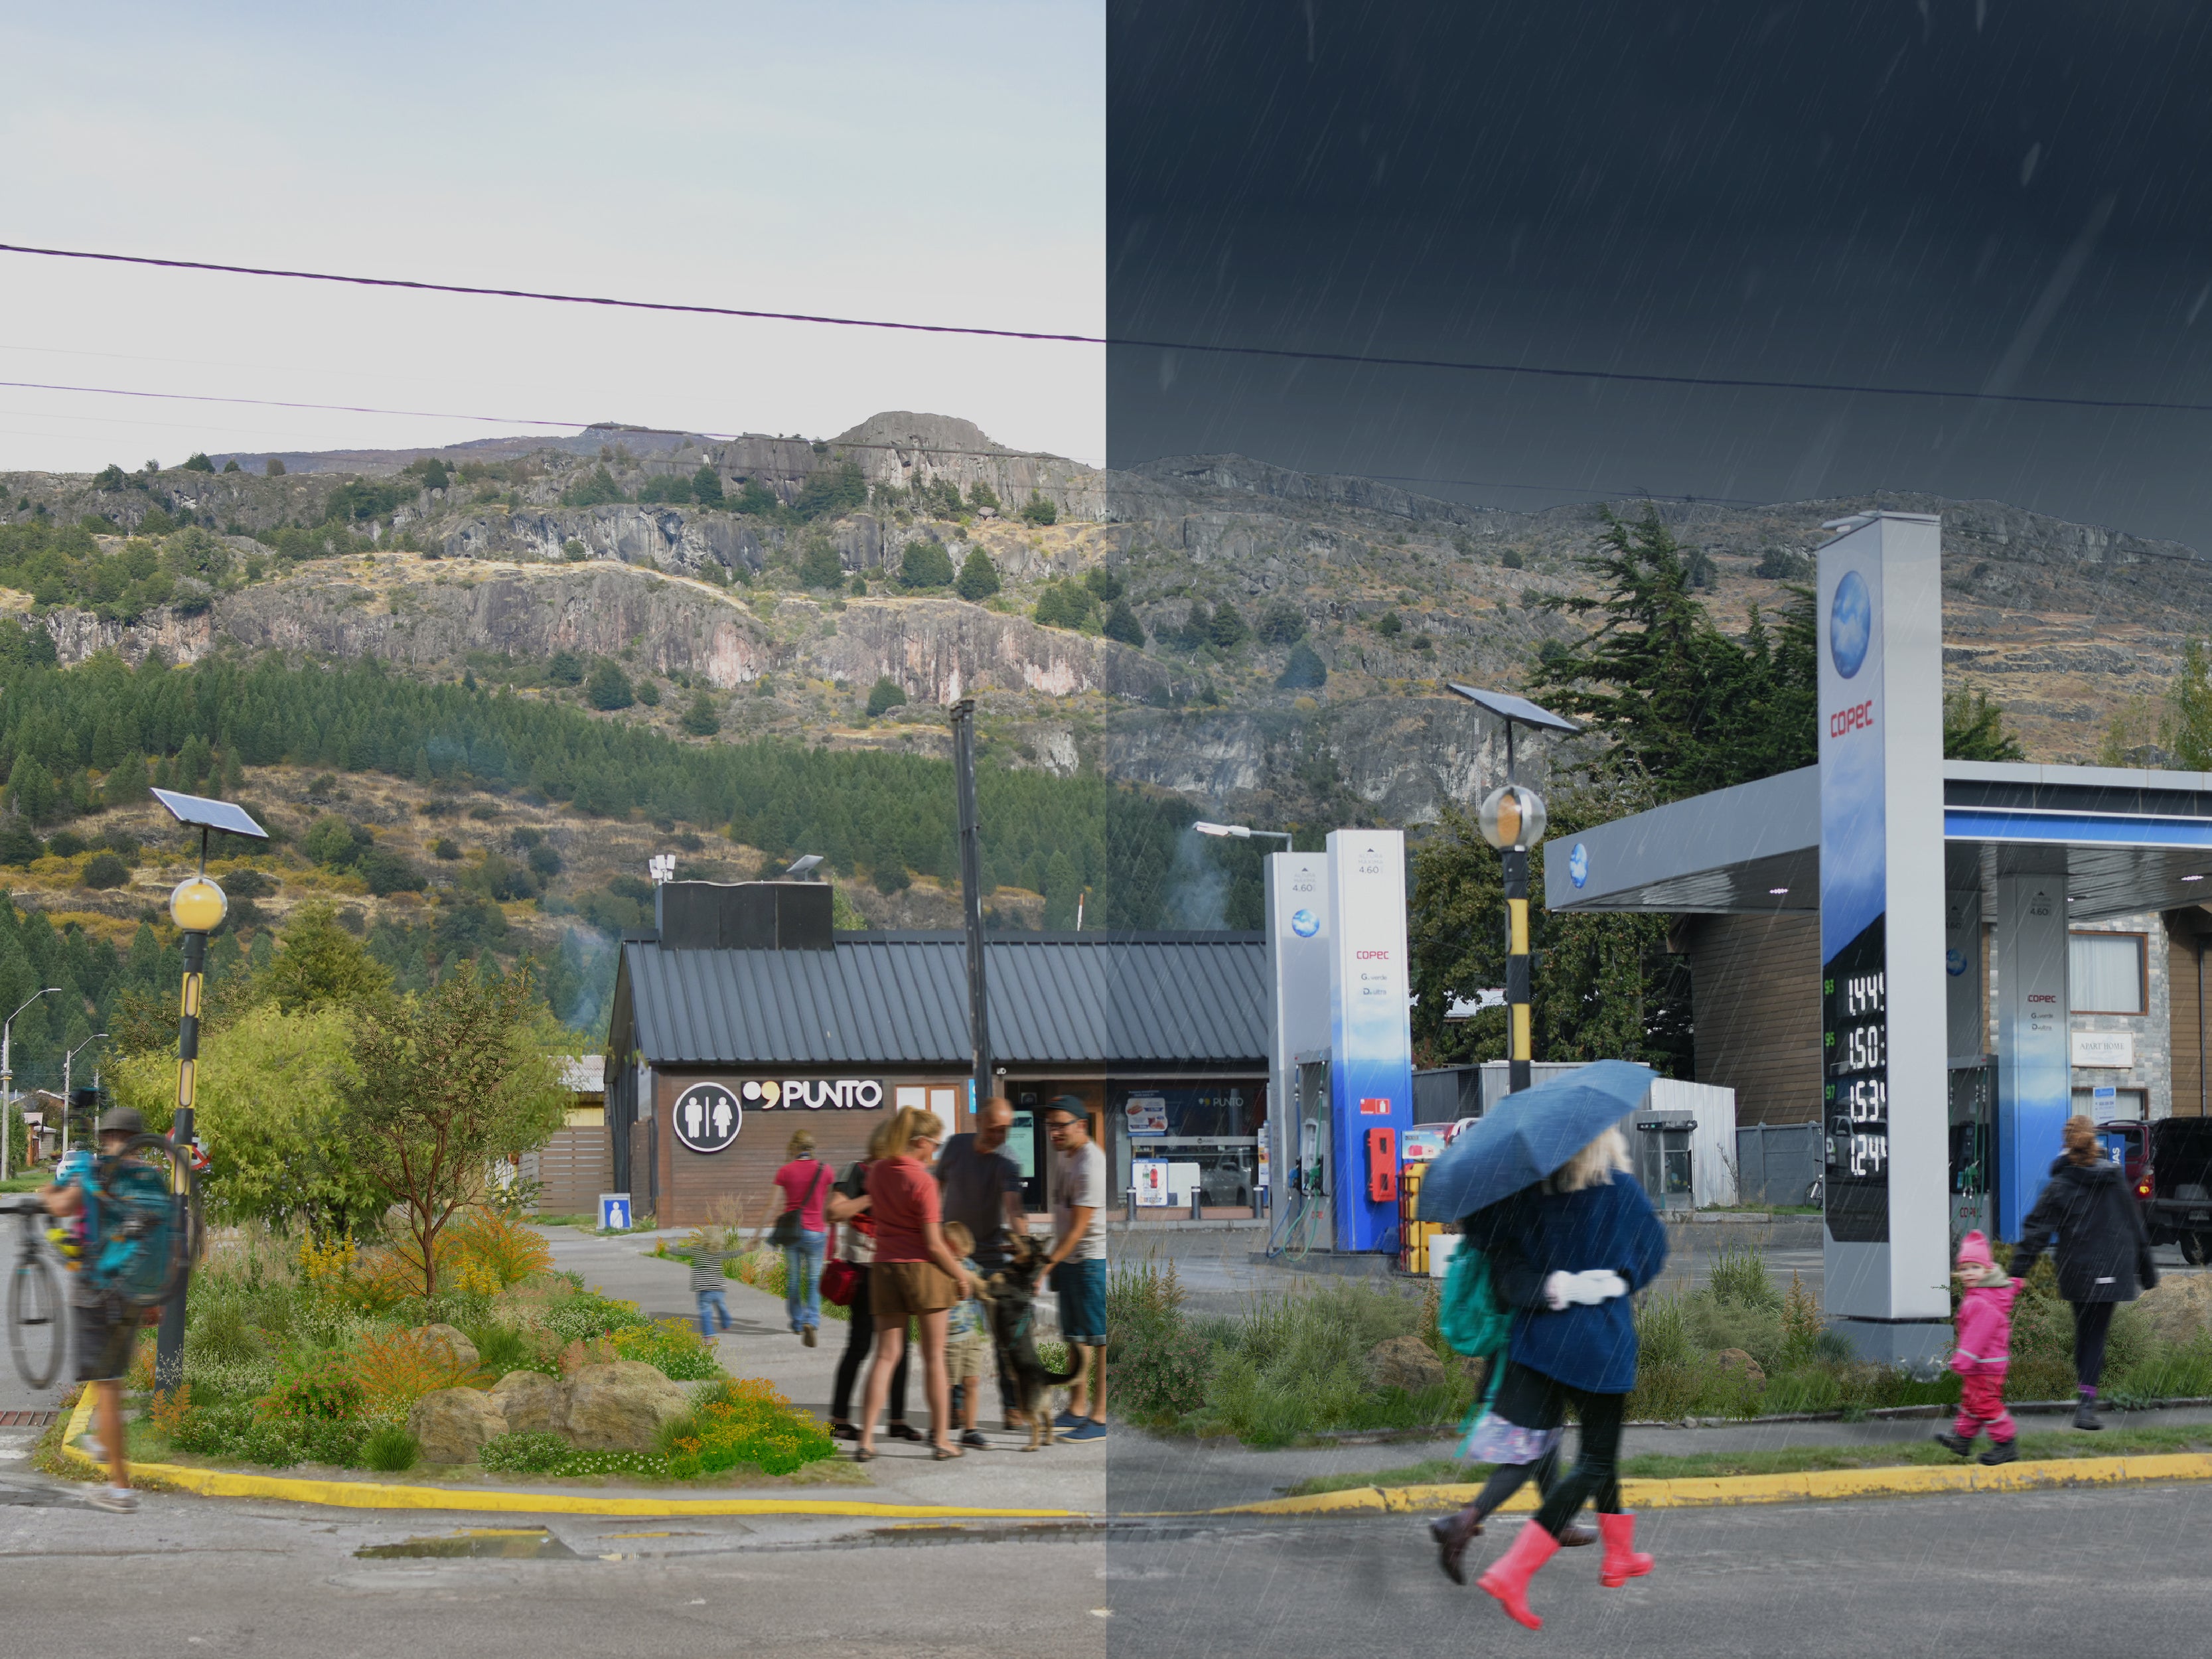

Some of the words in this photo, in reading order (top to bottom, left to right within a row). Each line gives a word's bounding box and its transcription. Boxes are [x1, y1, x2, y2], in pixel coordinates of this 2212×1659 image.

[1824, 979, 1835, 995] 93
[1825, 1031, 1836, 1047] 95
[1850, 1025, 1885, 1069] 1.50
[782, 1080, 883, 1108] PUNTO
[1826, 1084, 1836, 1100] 97
[1213, 1098, 1244, 1107] PUNTO
